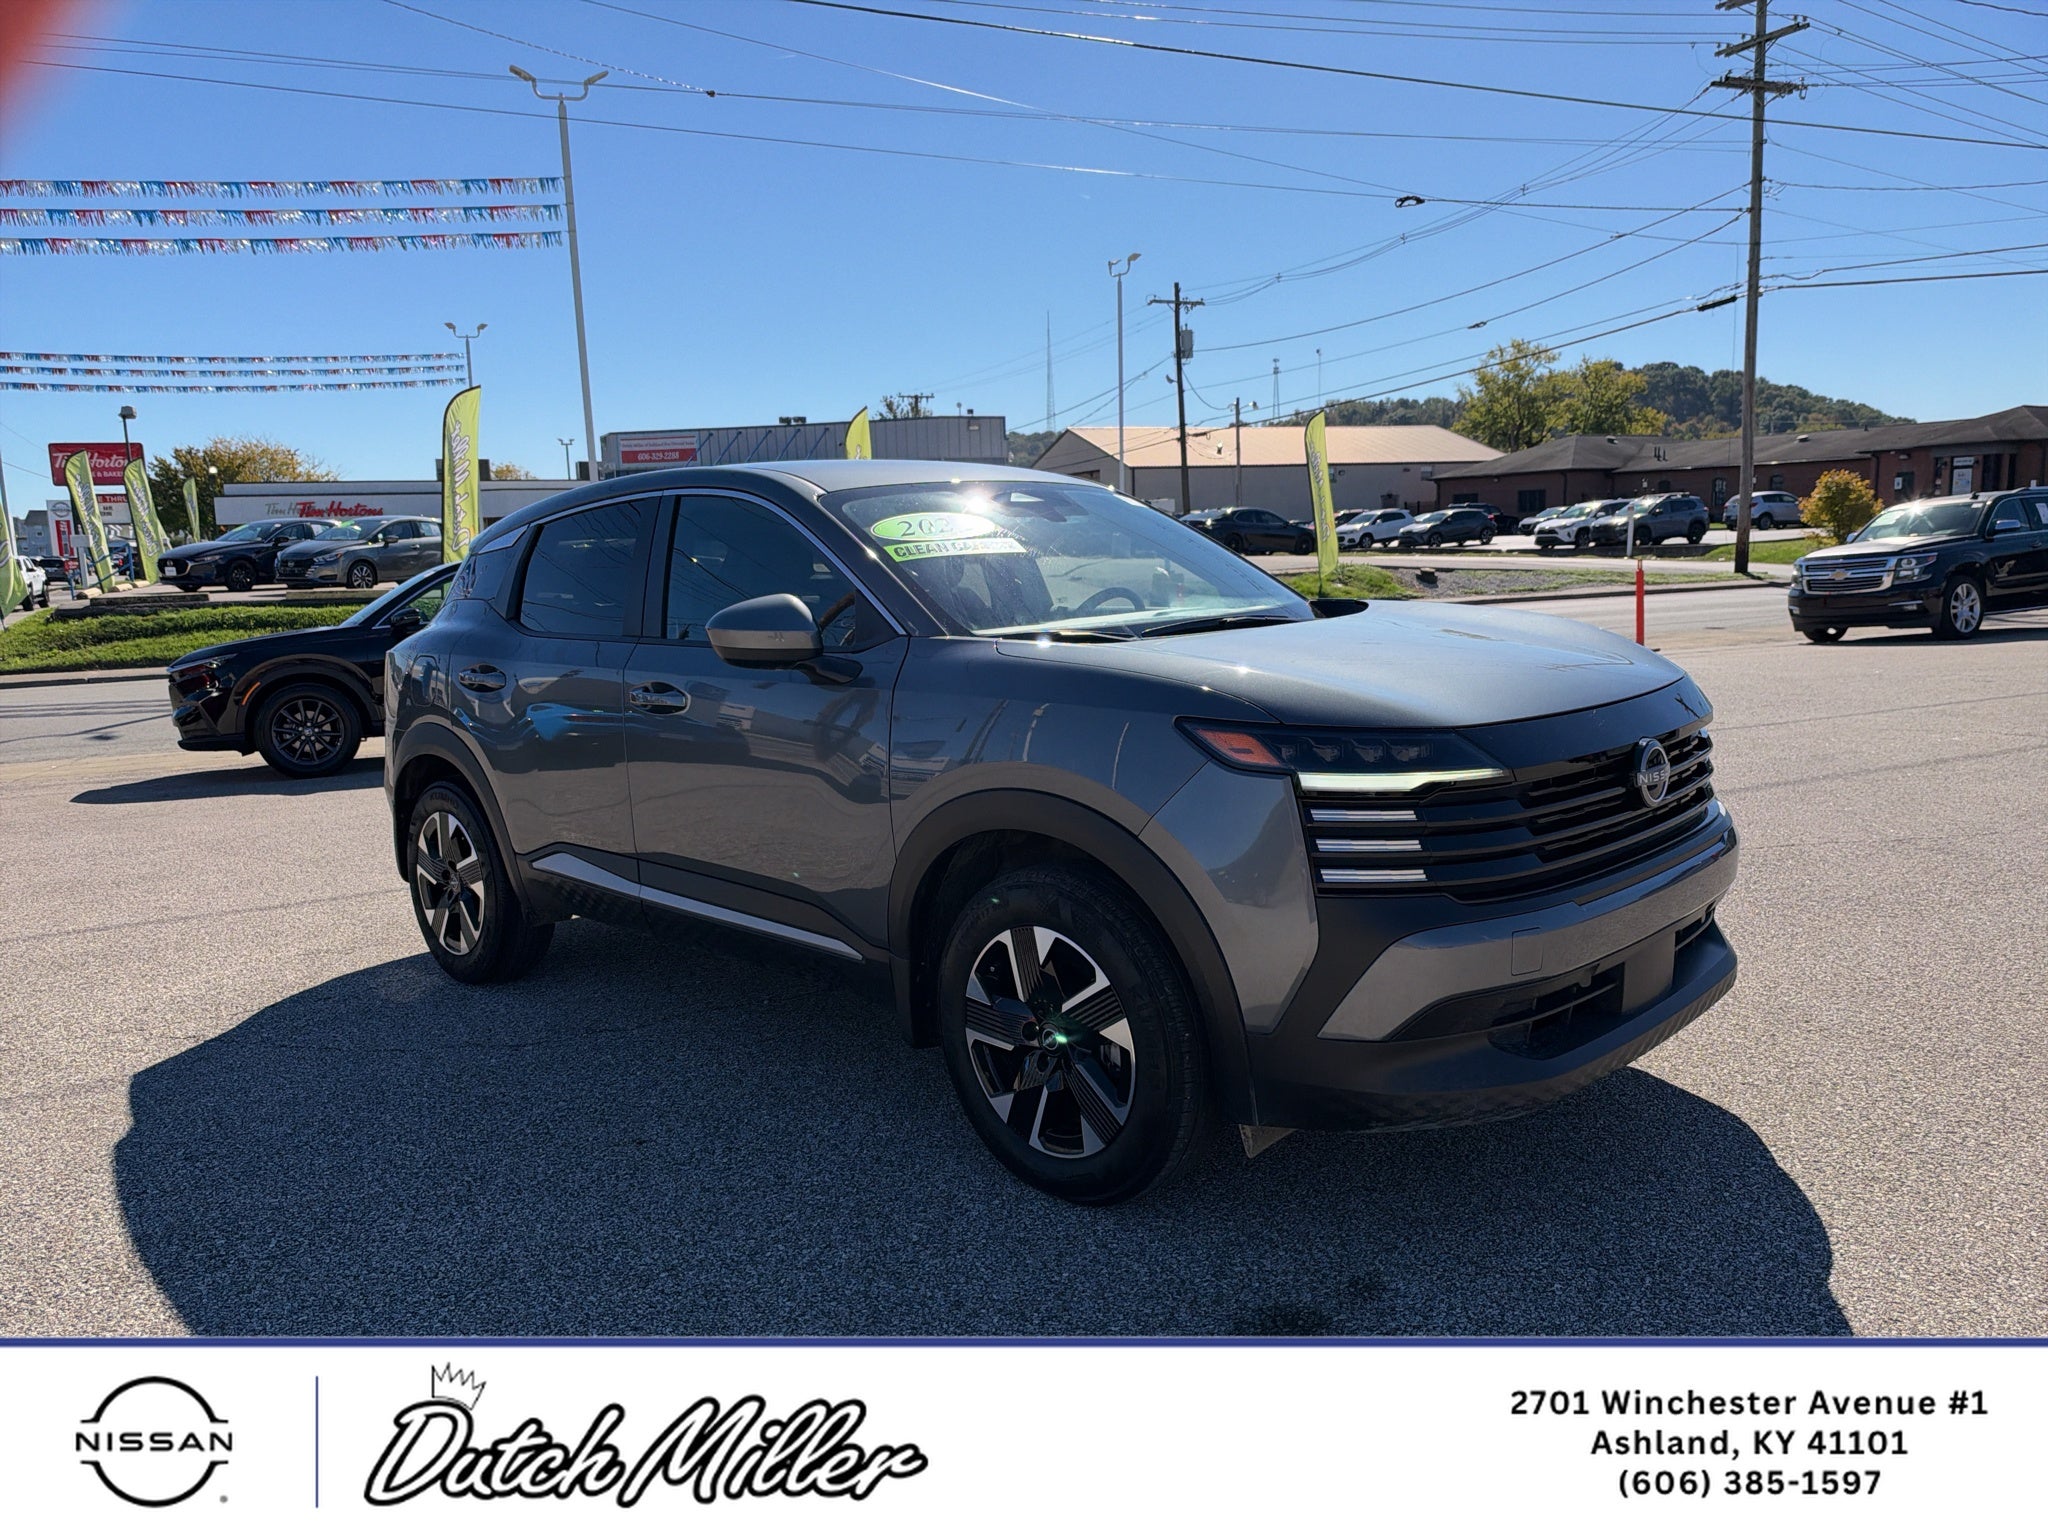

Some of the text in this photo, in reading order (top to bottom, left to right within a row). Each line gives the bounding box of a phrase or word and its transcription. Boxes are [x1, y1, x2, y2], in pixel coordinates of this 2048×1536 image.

[87, 451, 129, 468] Horto
[296, 501, 325, 518] Tim
[326, 500, 384, 517] Hortons
[896, 518, 964, 537] 202
[894, 542, 949, 558] CLEAN
